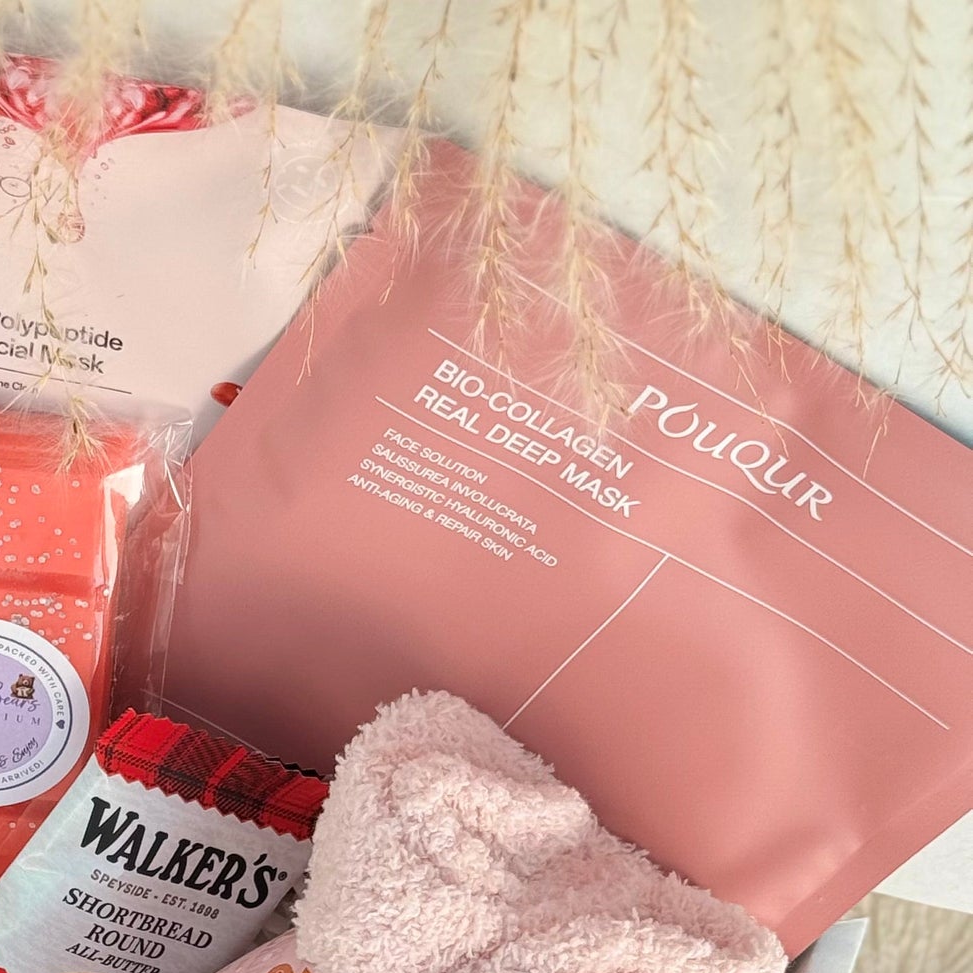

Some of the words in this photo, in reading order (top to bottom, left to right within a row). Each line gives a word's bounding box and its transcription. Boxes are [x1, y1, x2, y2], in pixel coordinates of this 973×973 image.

[432, 359, 634, 480] BIO-COLLAGEN
[383, 427, 422, 454] FACE
[419, 447, 488, 485] SOLUTION
[414, 385, 480, 435] REAL
[484, 424, 562, 475] DEEP
[559, 462, 643, 518] MASK
[346, 473, 424, 515] ANTI-AGING
[423, 508, 436, 521] &
[434, 513, 482, 544] REPAIR
[480, 537, 514, 561] SKIN
[360, 458, 446, 504] SYNERGISTIC
[444, 497, 526, 548] HYALURONIC
[523, 544, 558, 568] ACID
[371, 443, 450, 488] SAUSSUREA
[450, 481, 538, 535] INVOLUCRATA
[37, 665, 57, 690] WITH
[54, 691, 65, 717] CARE
[0, 759, 45, 784] ARRIVED!
[11, 737, 40, 764] Enjoy
[62, 887, 214, 950] SHORTBREAD
[90, 868, 153, 900] SPEYSIDE
[160, 893, 188, 911] EST.
[84, 923, 166, 961] ROUND
